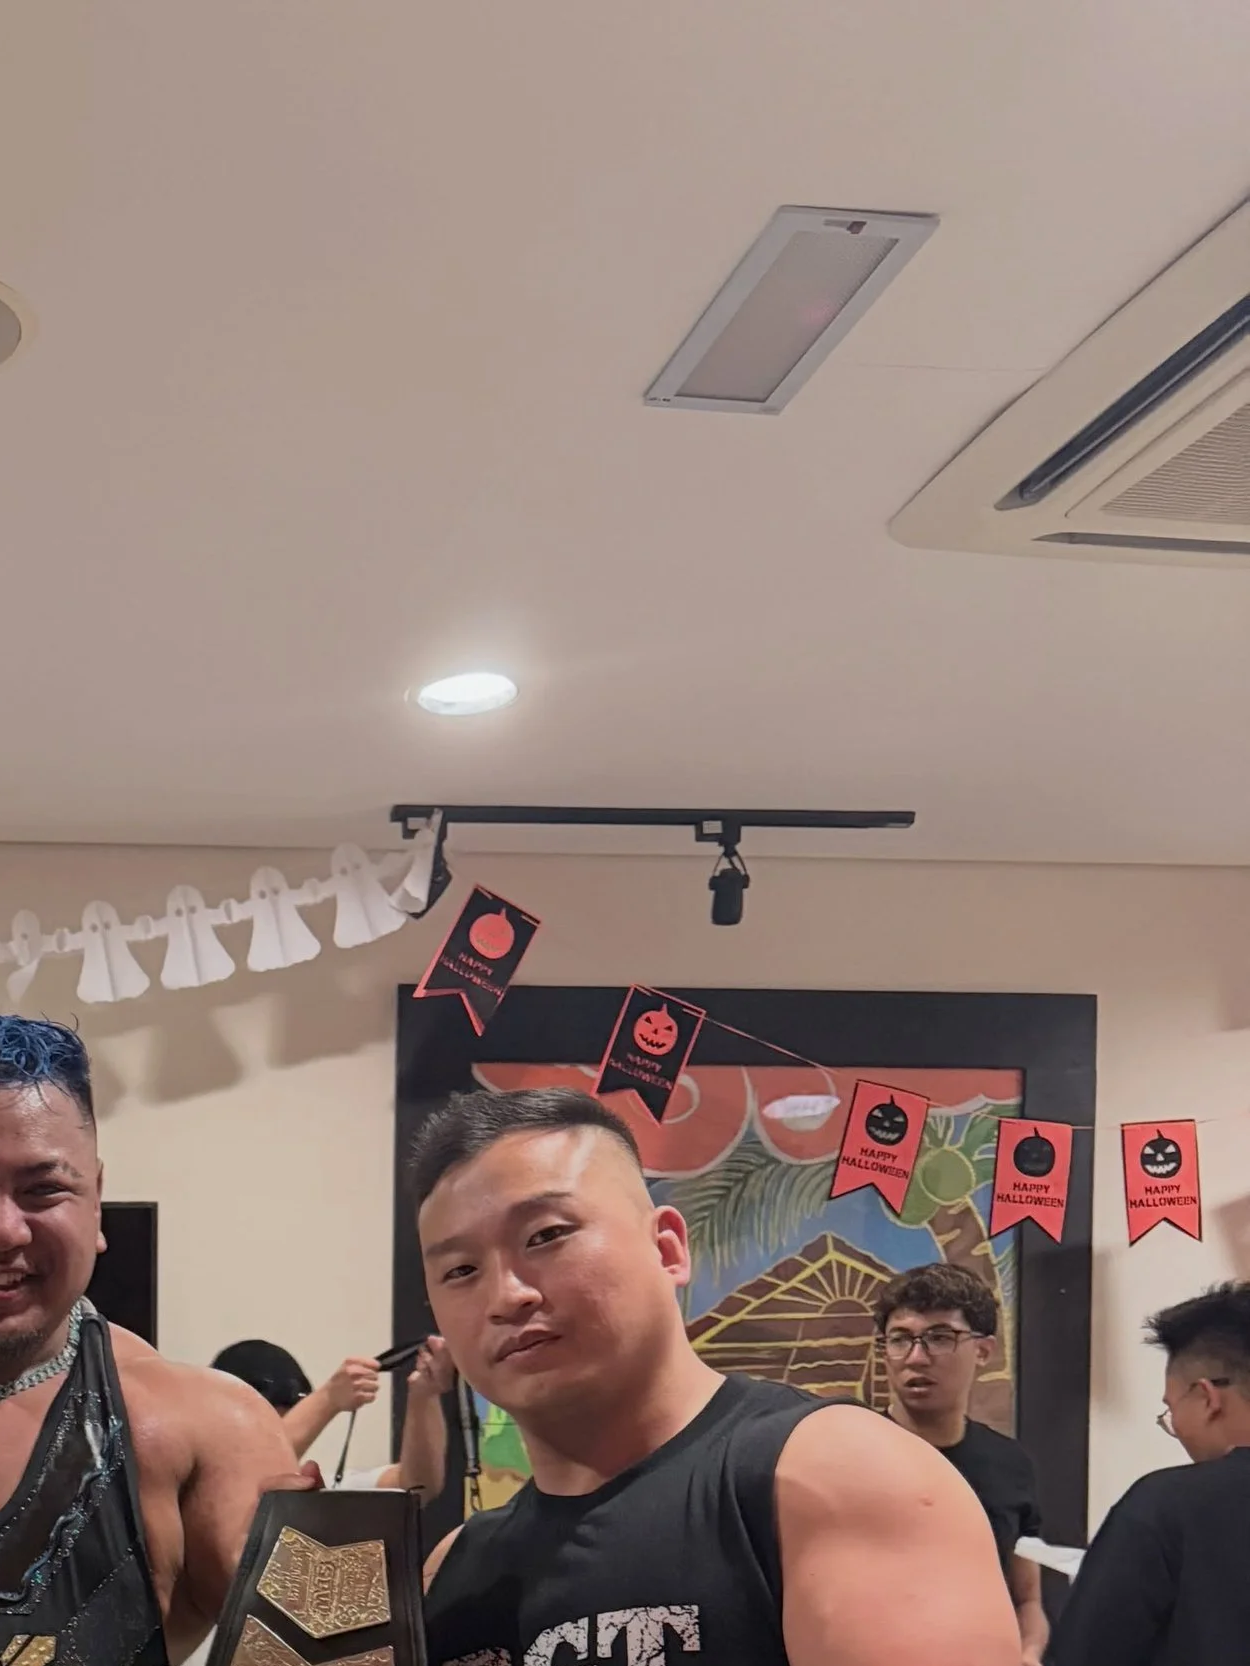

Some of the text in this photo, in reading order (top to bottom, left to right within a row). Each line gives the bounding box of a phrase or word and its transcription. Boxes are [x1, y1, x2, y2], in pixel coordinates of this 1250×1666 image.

[859, 1147, 898, 1163] HAPPY
[841, 1155, 909, 1180] HALLOWEEN
[1013, 1182, 1051, 1194] HAPPY
[1144, 1184, 1181, 1195] HAPPY
[997, 1193, 1064, 1208] HALLOWEEN
[1129, 1196, 1197, 1209] HALLOWEEN
